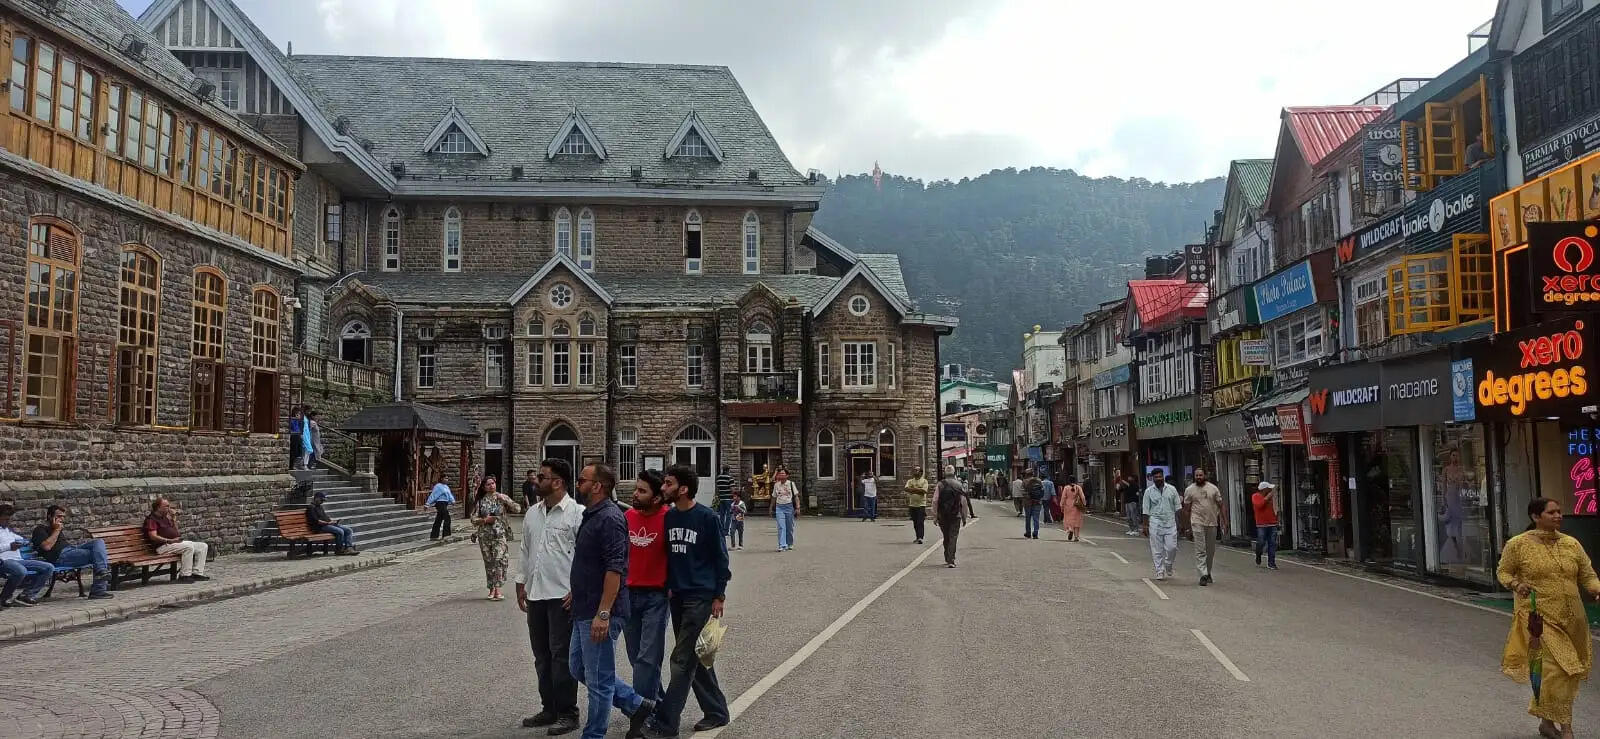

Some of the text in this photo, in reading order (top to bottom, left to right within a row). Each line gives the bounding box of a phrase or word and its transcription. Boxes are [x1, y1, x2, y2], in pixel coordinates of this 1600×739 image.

[1368, 126, 1401, 140] wak
[1525, 139, 1560, 166] PARMAR
[1561, 119, 1600, 146] ADVOCA
[1371, 169, 1402, 182] bak
[1403, 193, 1475, 238] wake bake
[1360, 214, 1405, 249] WILDCRAFT
[1543, 290, 1600, 306] degree
[1519, 330, 1583, 368] xero
[1332, 385, 1379, 407] WILDCRAFT
[1478, 365, 1587, 416] degrees
[1569, 429, 1600, 440] HER
